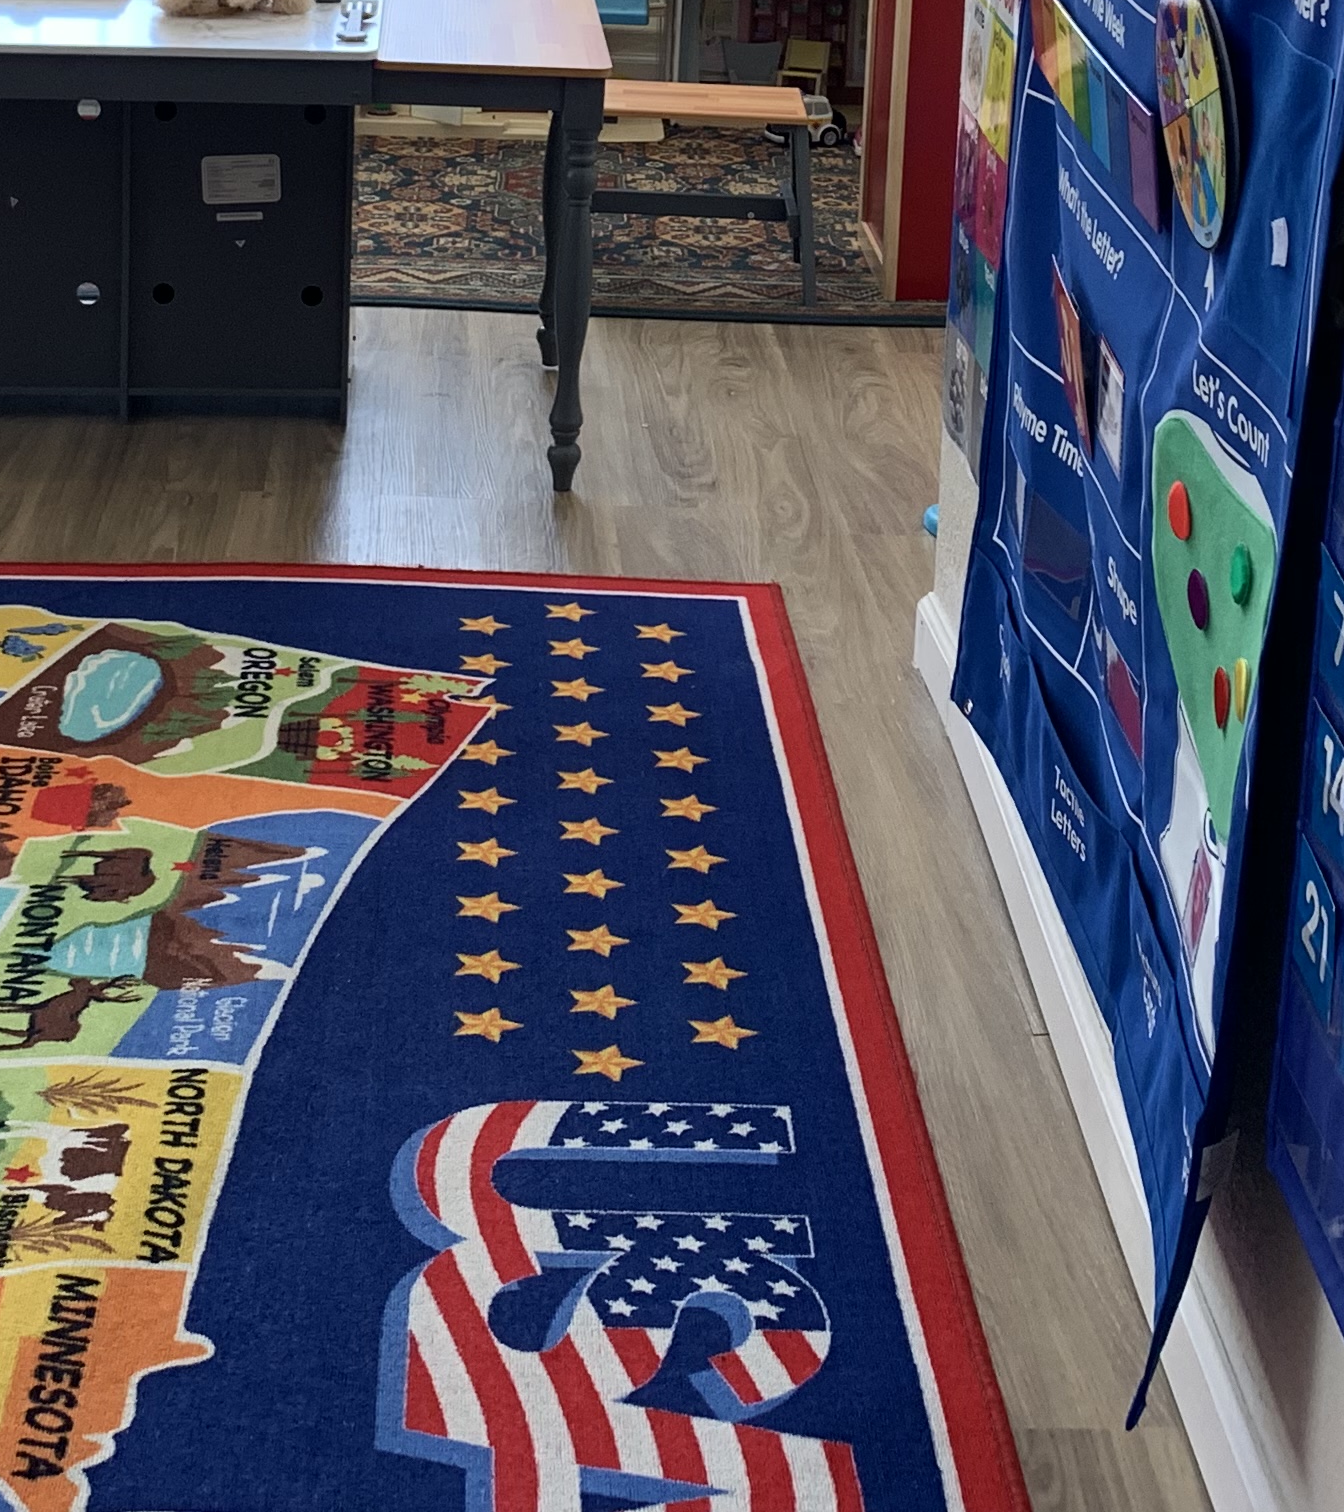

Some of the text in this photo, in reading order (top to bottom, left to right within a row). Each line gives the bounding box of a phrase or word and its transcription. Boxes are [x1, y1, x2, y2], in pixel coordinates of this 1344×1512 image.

[1092, 218, 1125, 281] Letter?
[1012, 381, 1048, 444] Rhyme
[1190, 358, 1271, 469] Let's Count
[232, 647, 278, 719] OREGON
[296, 656, 321, 688] Salem
[361, 684, 395, 783] WASHINGTON
[30, 756, 65, 788] Boise
[198, 837, 234, 881] Helena
[1049, 796, 1088, 863] Letters
[1300, 878, 1330, 985] 21
[135, 1067, 210, 1265] NORTH DAKOTA
[10, 1272, 103, 1482] MINNESOTA
